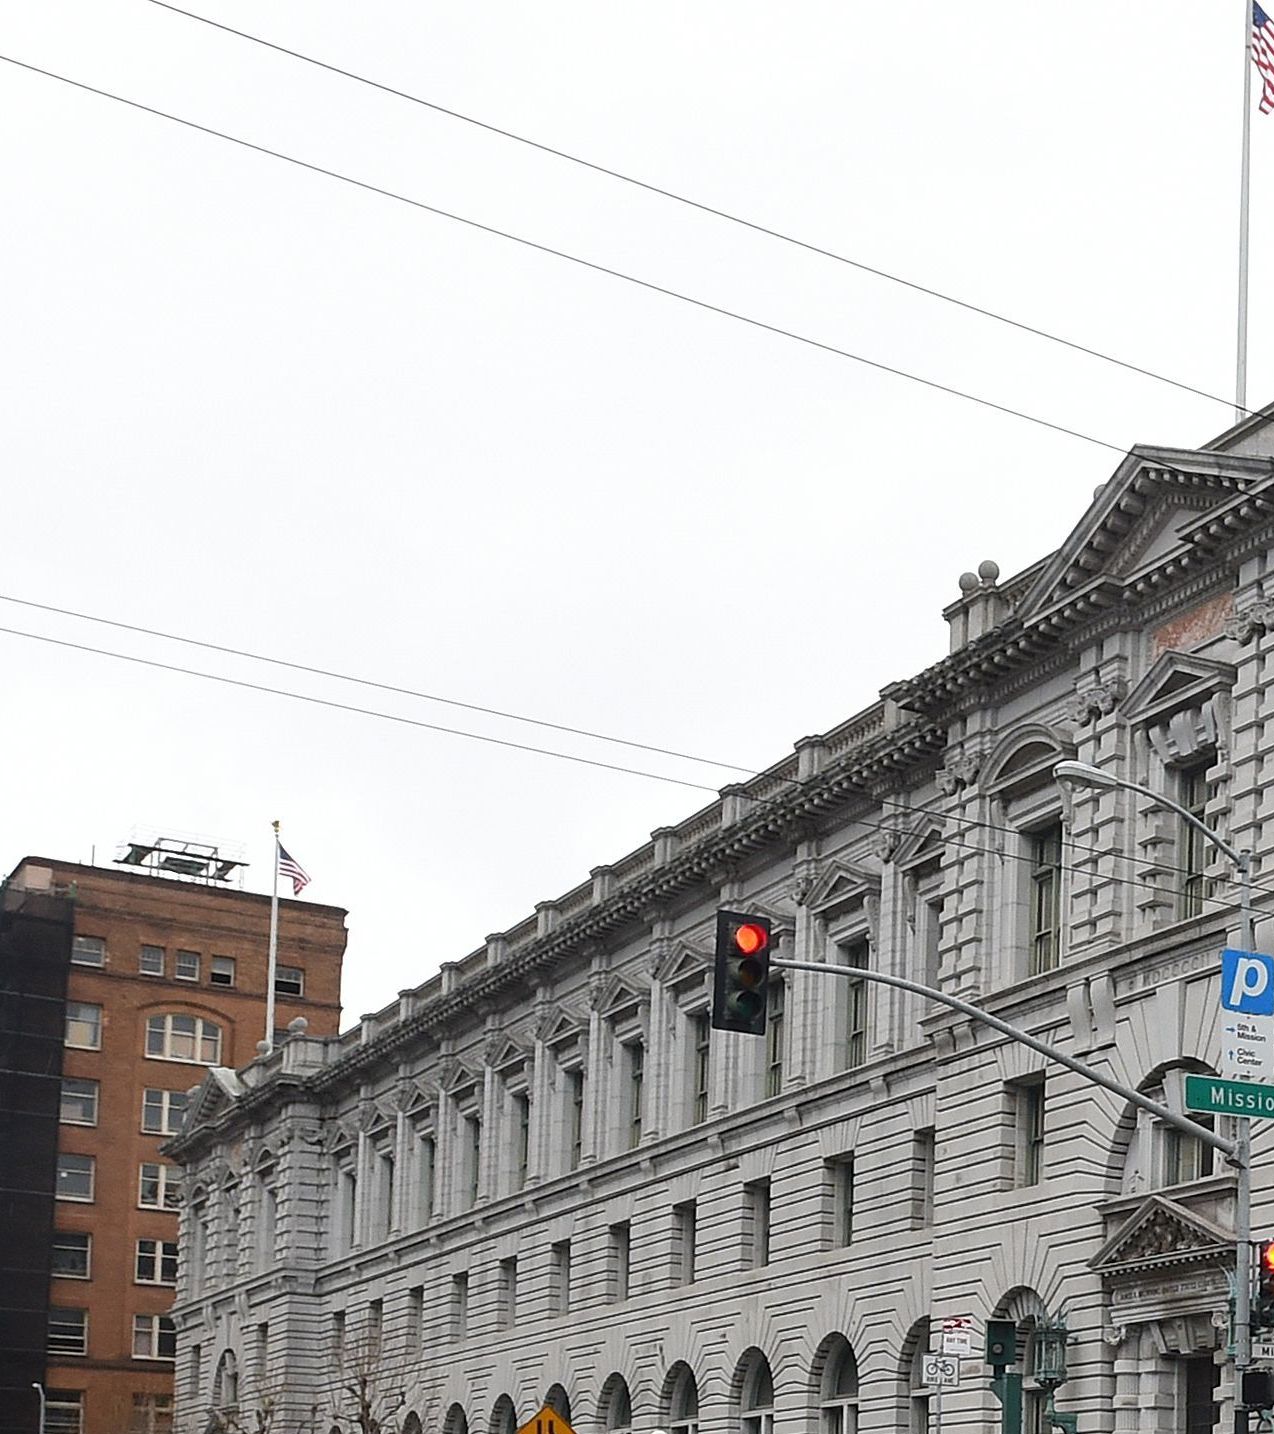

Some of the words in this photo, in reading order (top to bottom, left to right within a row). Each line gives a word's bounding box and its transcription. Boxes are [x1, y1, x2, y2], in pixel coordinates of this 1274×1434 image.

[1237, 1031, 1267, 1043] Mission
[1237, 1047, 1256, 1057] Civic
[1237, 1056, 1263, 1067] Center
